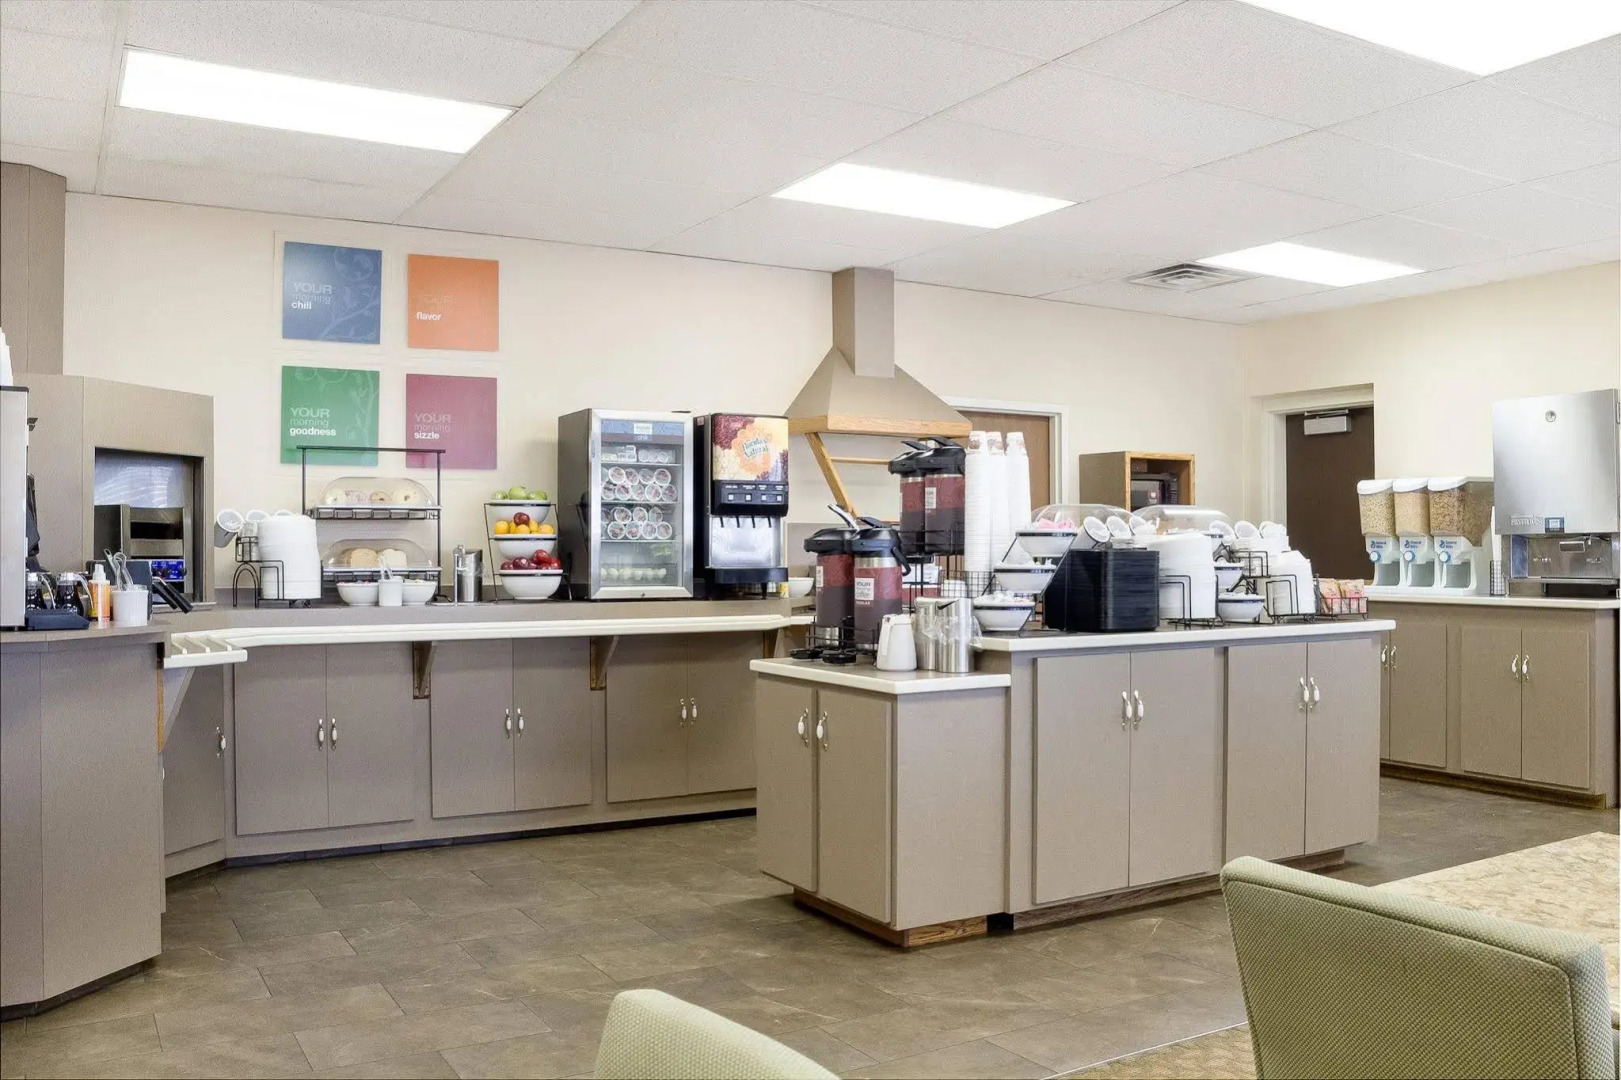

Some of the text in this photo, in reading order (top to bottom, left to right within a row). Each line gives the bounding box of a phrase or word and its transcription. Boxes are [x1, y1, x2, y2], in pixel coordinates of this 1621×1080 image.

[292, 282, 332, 295] YOUR
[291, 300, 312, 310] chill
[416, 311, 441, 321] flavor
[290, 407, 330, 418] YOUR
[414, 412, 451, 423] YOUR
[290, 418, 329, 429] morning
[289, 427, 337, 437] goodness
[413, 430, 440, 440] sizzle
